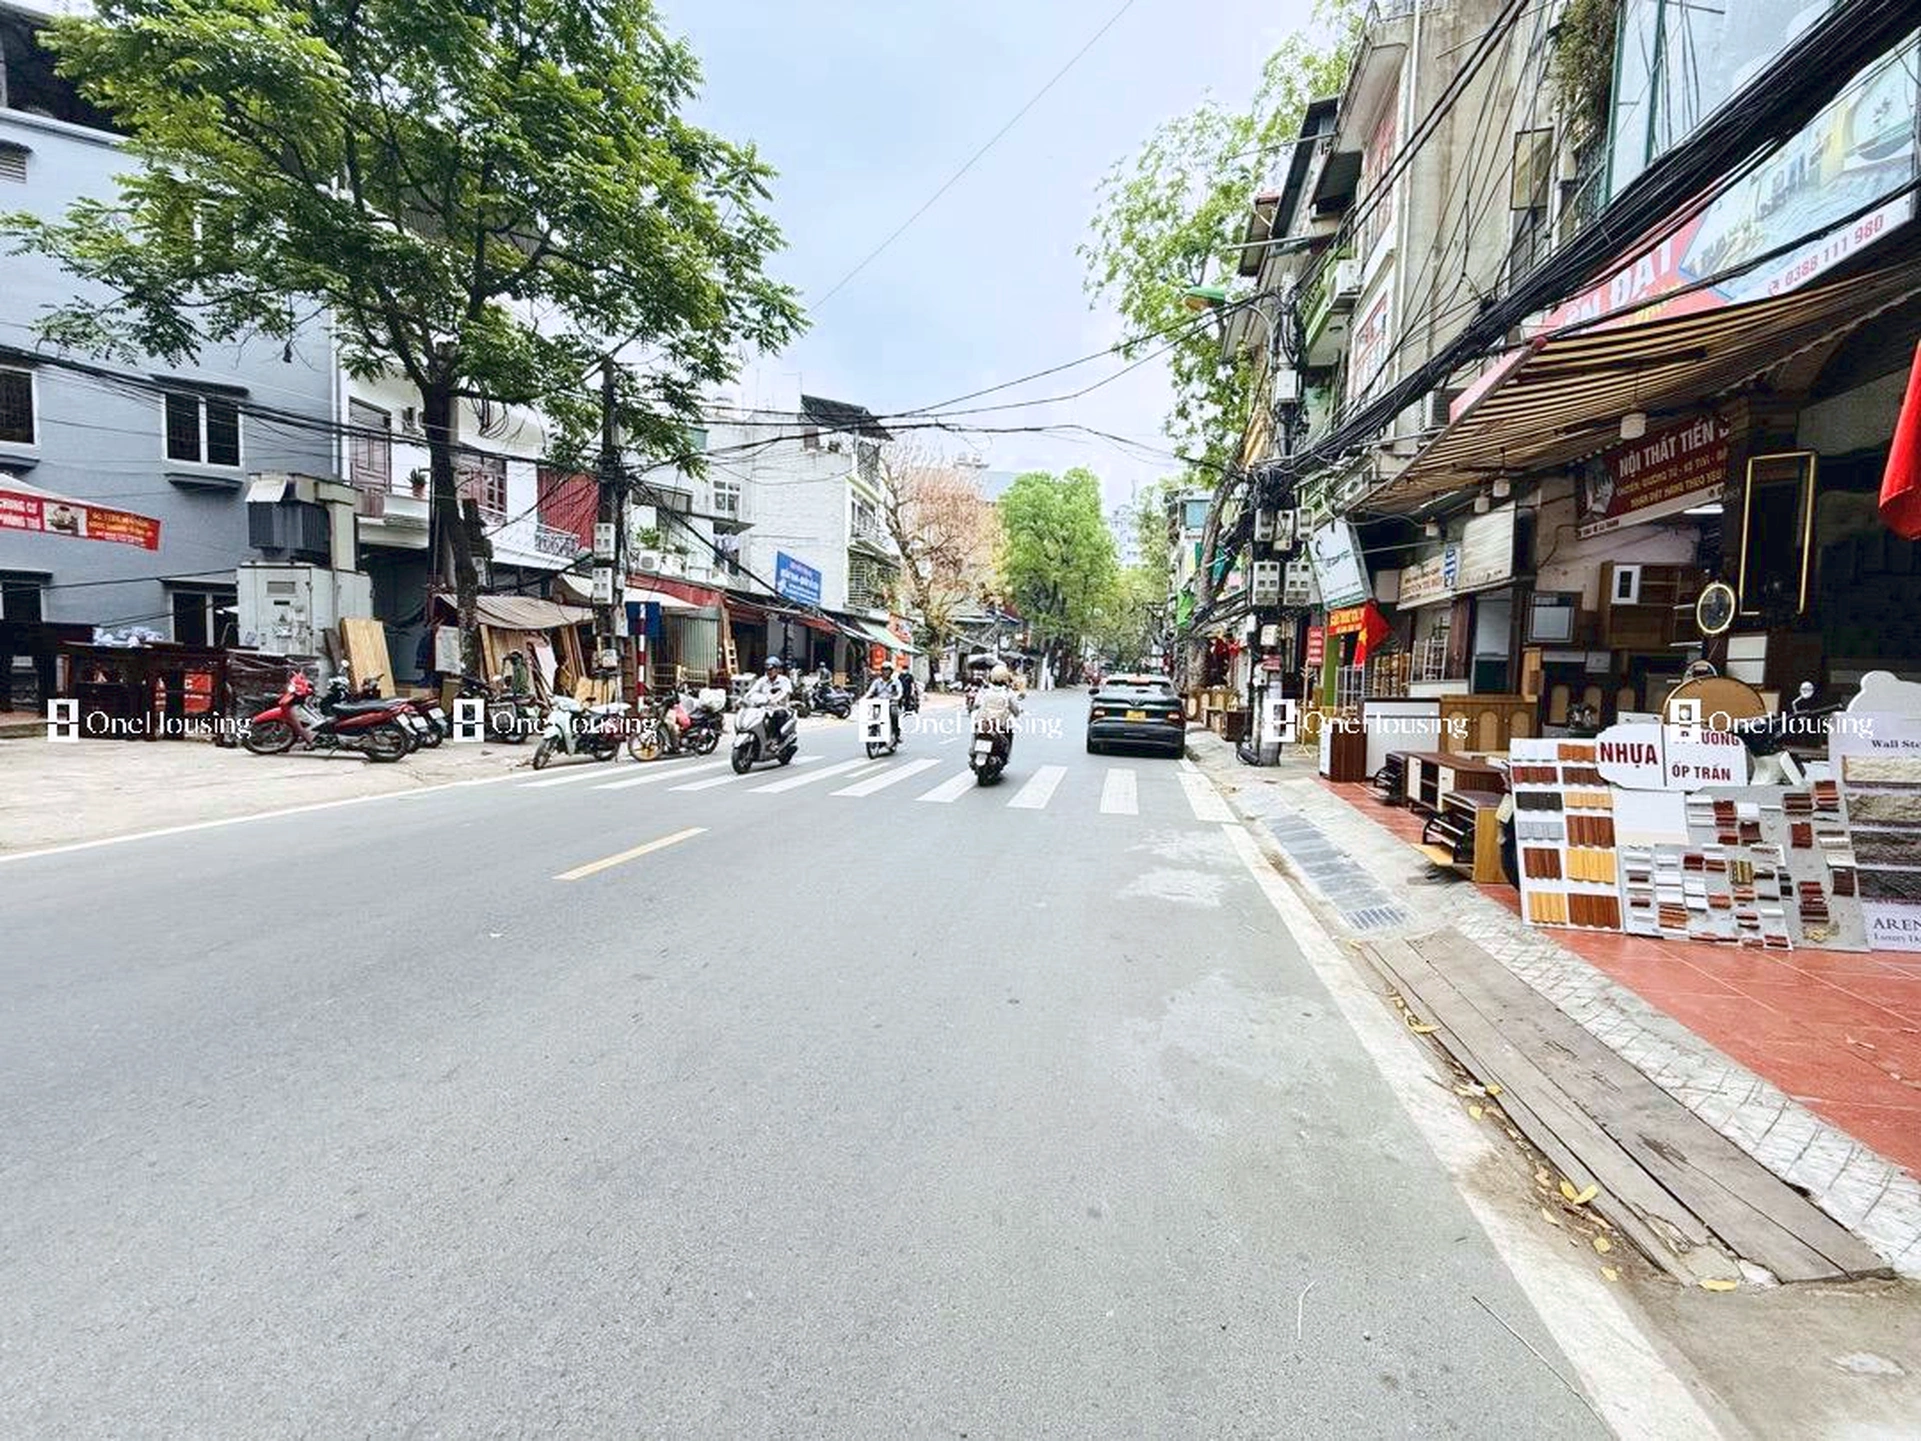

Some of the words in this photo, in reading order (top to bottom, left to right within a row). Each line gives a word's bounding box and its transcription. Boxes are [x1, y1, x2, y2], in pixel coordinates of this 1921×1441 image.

[1785, 255, 1818, 286] 0388
[1823, 236, 1847, 262] 111
[1855, 214, 1884, 244] 980
[1619, 451, 1640, 478] NỘI
[1643, 432, 1676, 468] THẤT
[1600, 742, 1658, 769] NHỰA
[1872, 740, 1899, 748] Wall
